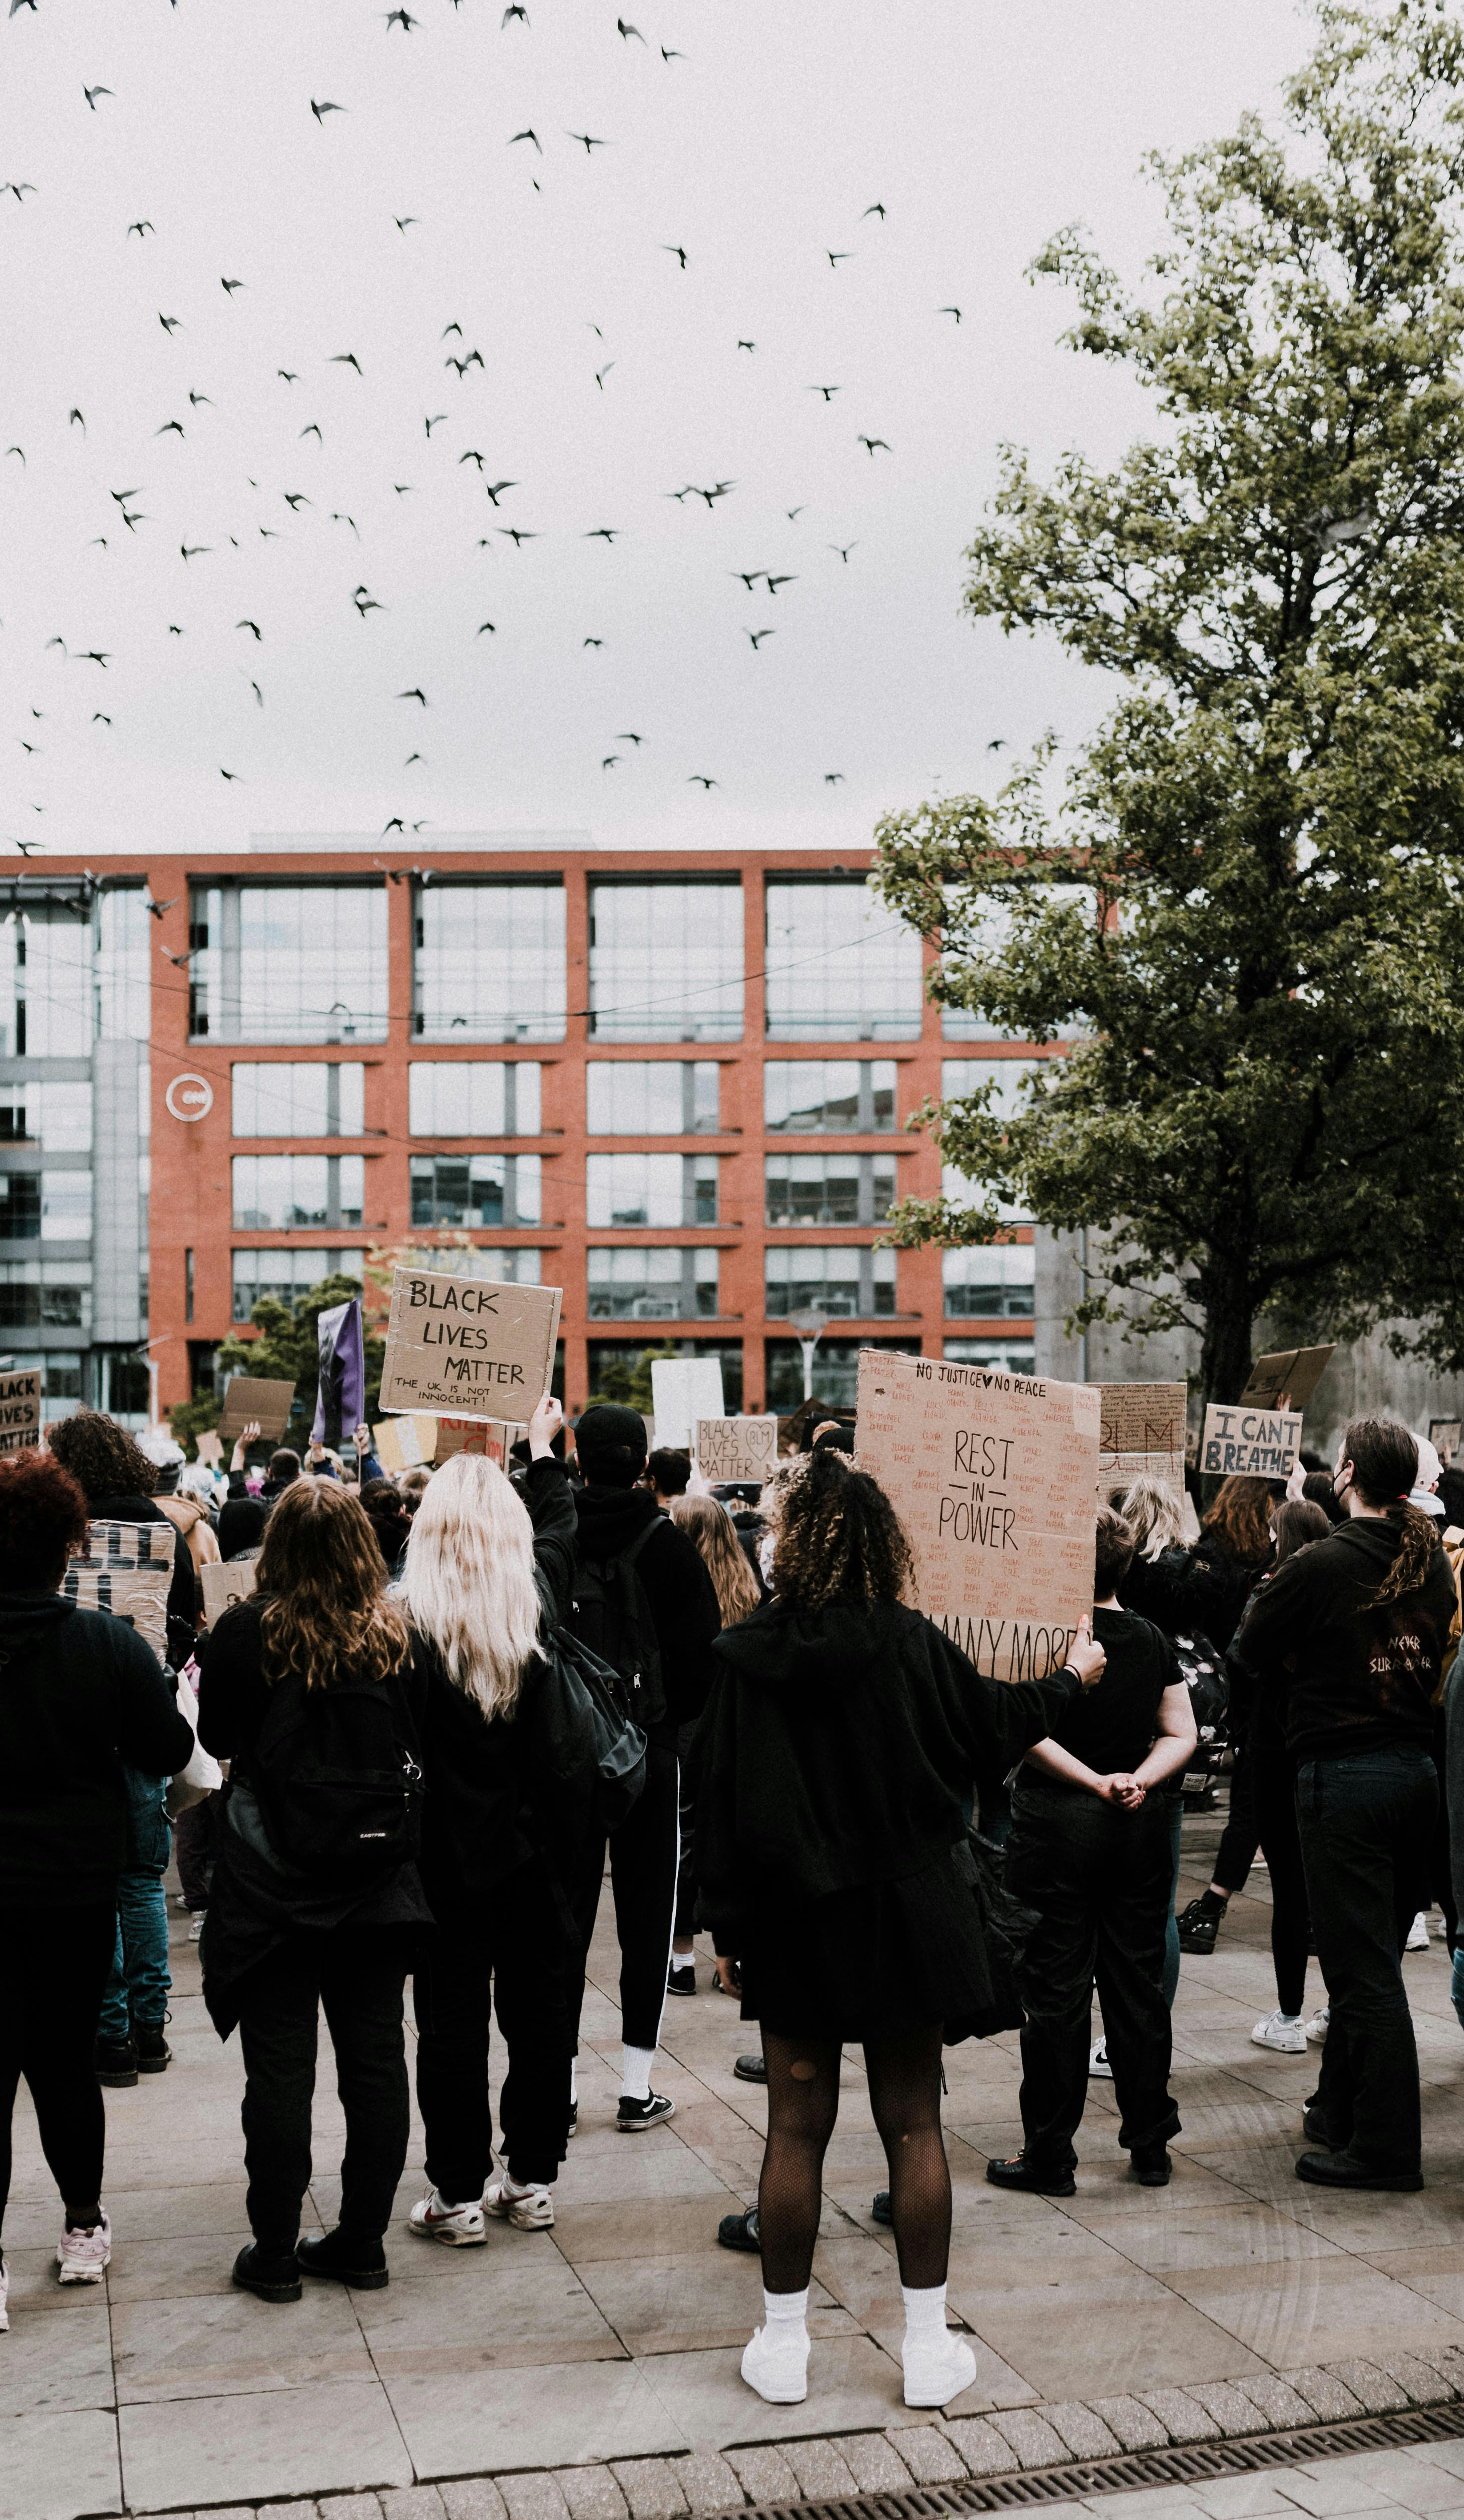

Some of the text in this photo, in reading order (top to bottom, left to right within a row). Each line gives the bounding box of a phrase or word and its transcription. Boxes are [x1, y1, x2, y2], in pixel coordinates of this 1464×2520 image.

[410, 1280, 499, 1314] BLACK
[423, 1322, 488, 1349] LIVES
[445, 1357, 525, 1384] MATTER
[917, 1363, 1046, 1397] NO JUSTICE NO PEACE
[394, 1378, 418, 1388] THE
[428, 1383, 442, 1391] UK
[419, 1392, 485, 1406] INNOCENT!
[700, 1421, 739, 1440] BLACK
[750, 1431, 770, 1445] BLM
[1215, 1412, 1300, 1446] I CANT
[700, 1440, 739, 1458] LIVES
[955, 1430, 1014, 1480] REST
[1205, 1441, 1294, 1475] BREATHE
[700, 1459, 753, 1477] MATTER
[972, 1482, 984, 1502] IN
[939, 1497, 1018, 1551] POWER
[930, 1614, 1005, 1678] ANY
[1388, 1636, 1421, 1650] NEVER
